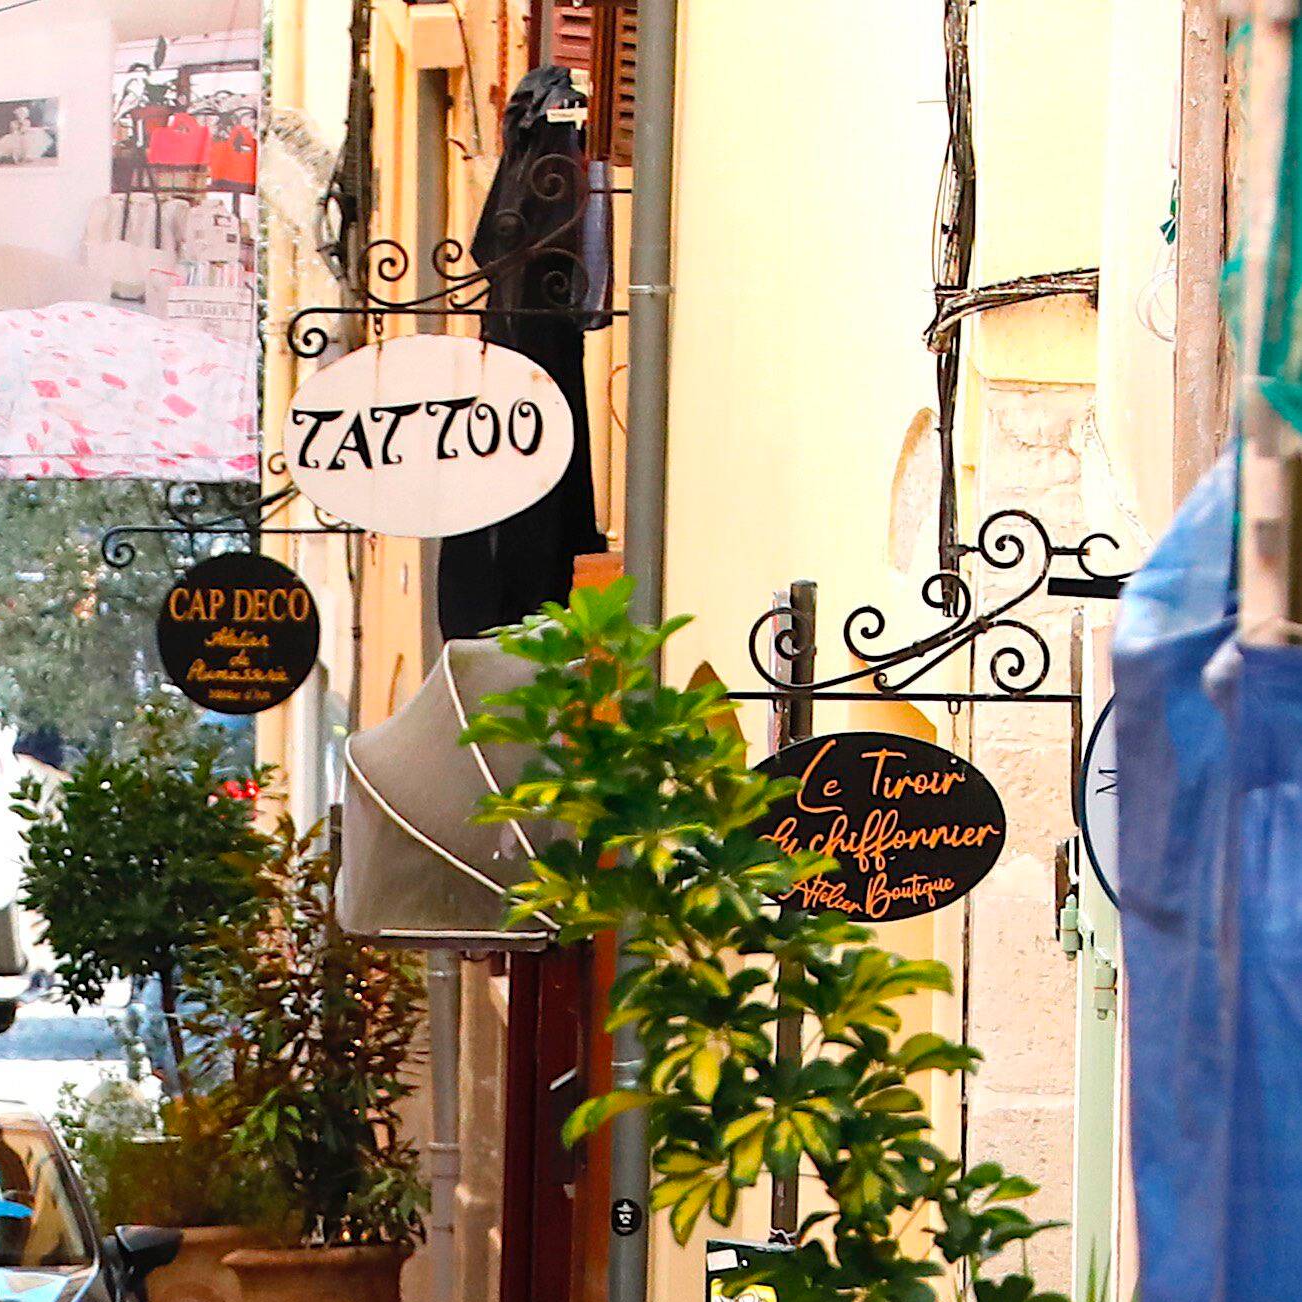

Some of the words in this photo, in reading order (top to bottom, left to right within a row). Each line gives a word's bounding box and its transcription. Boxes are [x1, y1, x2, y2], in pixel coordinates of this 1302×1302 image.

[291, 396, 544, 470] TATTOO
[169, 587, 226, 622] CAP
[232, 587, 310, 622] DECO
[797, 739, 842, 814] Le
[860, 748, 966, 800] Tiroir
[809, 809, 1001, 873] chiffonnier
[778, 872, 864, 914] Atelier
[865, 872, 956, 919] Boutique
